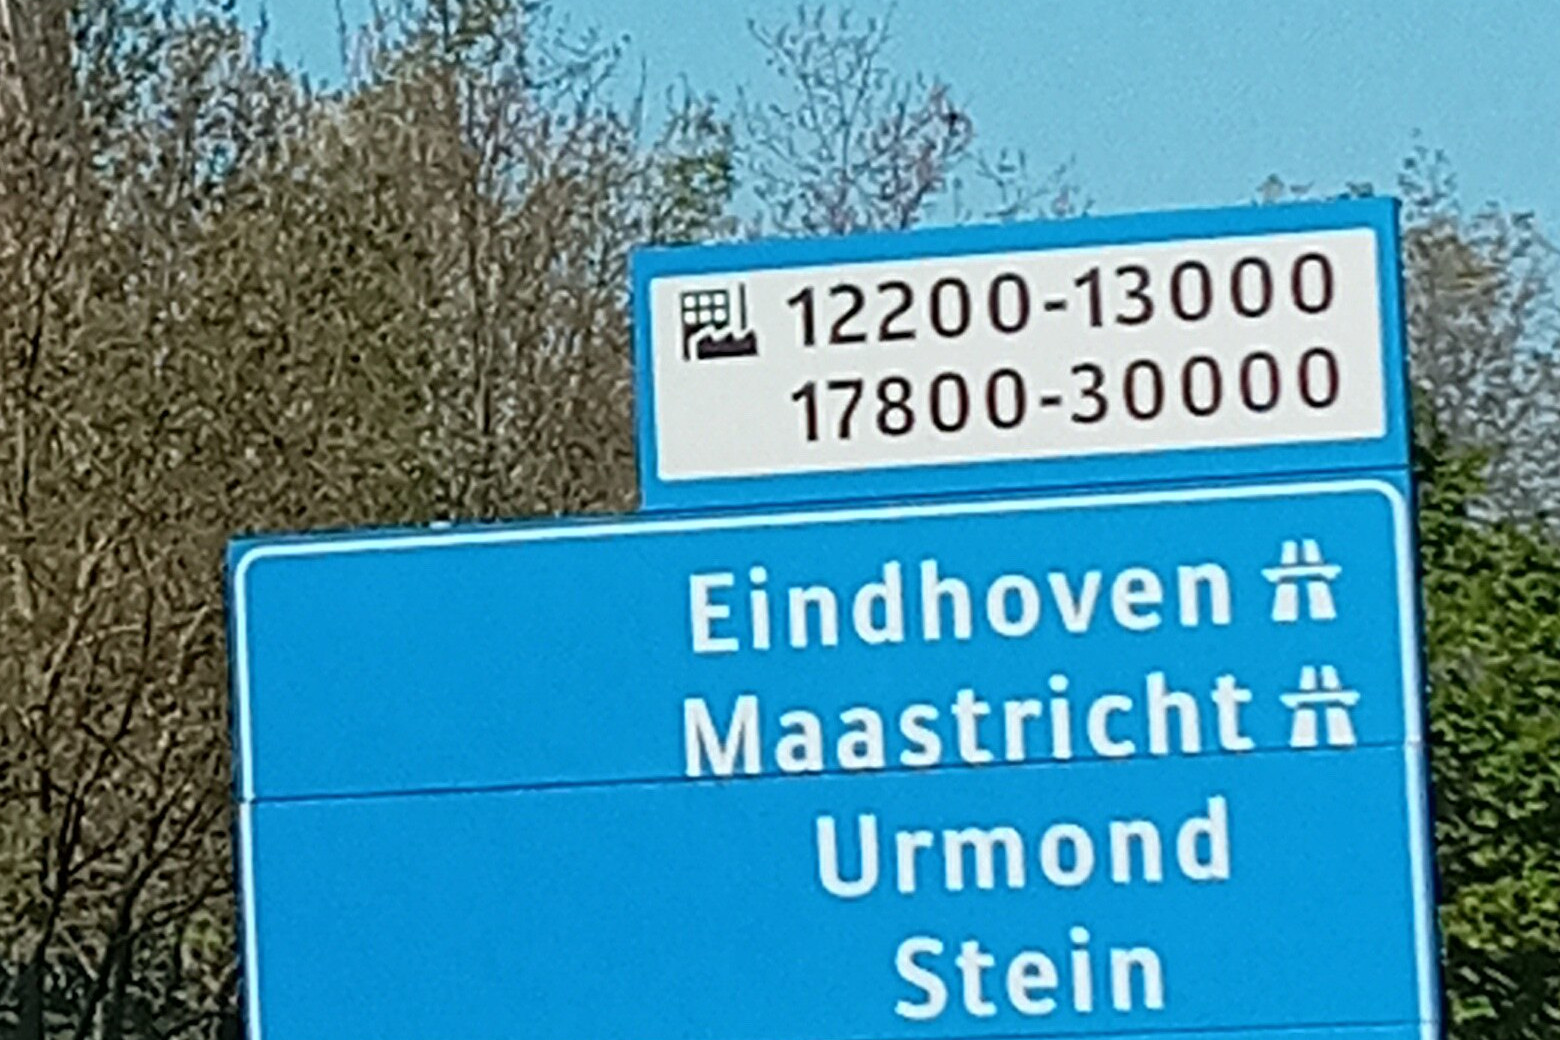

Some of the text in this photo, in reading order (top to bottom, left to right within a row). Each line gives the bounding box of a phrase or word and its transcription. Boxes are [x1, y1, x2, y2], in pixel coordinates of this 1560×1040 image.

[786, 251, 1335, 348] 12200-13000
[790, 346, 1340, 443] 17800-30000
[689, 558, 1232, 654] Eindhoven
[683, 671, 1255, 778] Maastricht
[816, 795, 1231, 898] Urmond
[895, 926, 1164, 1020] Stein
